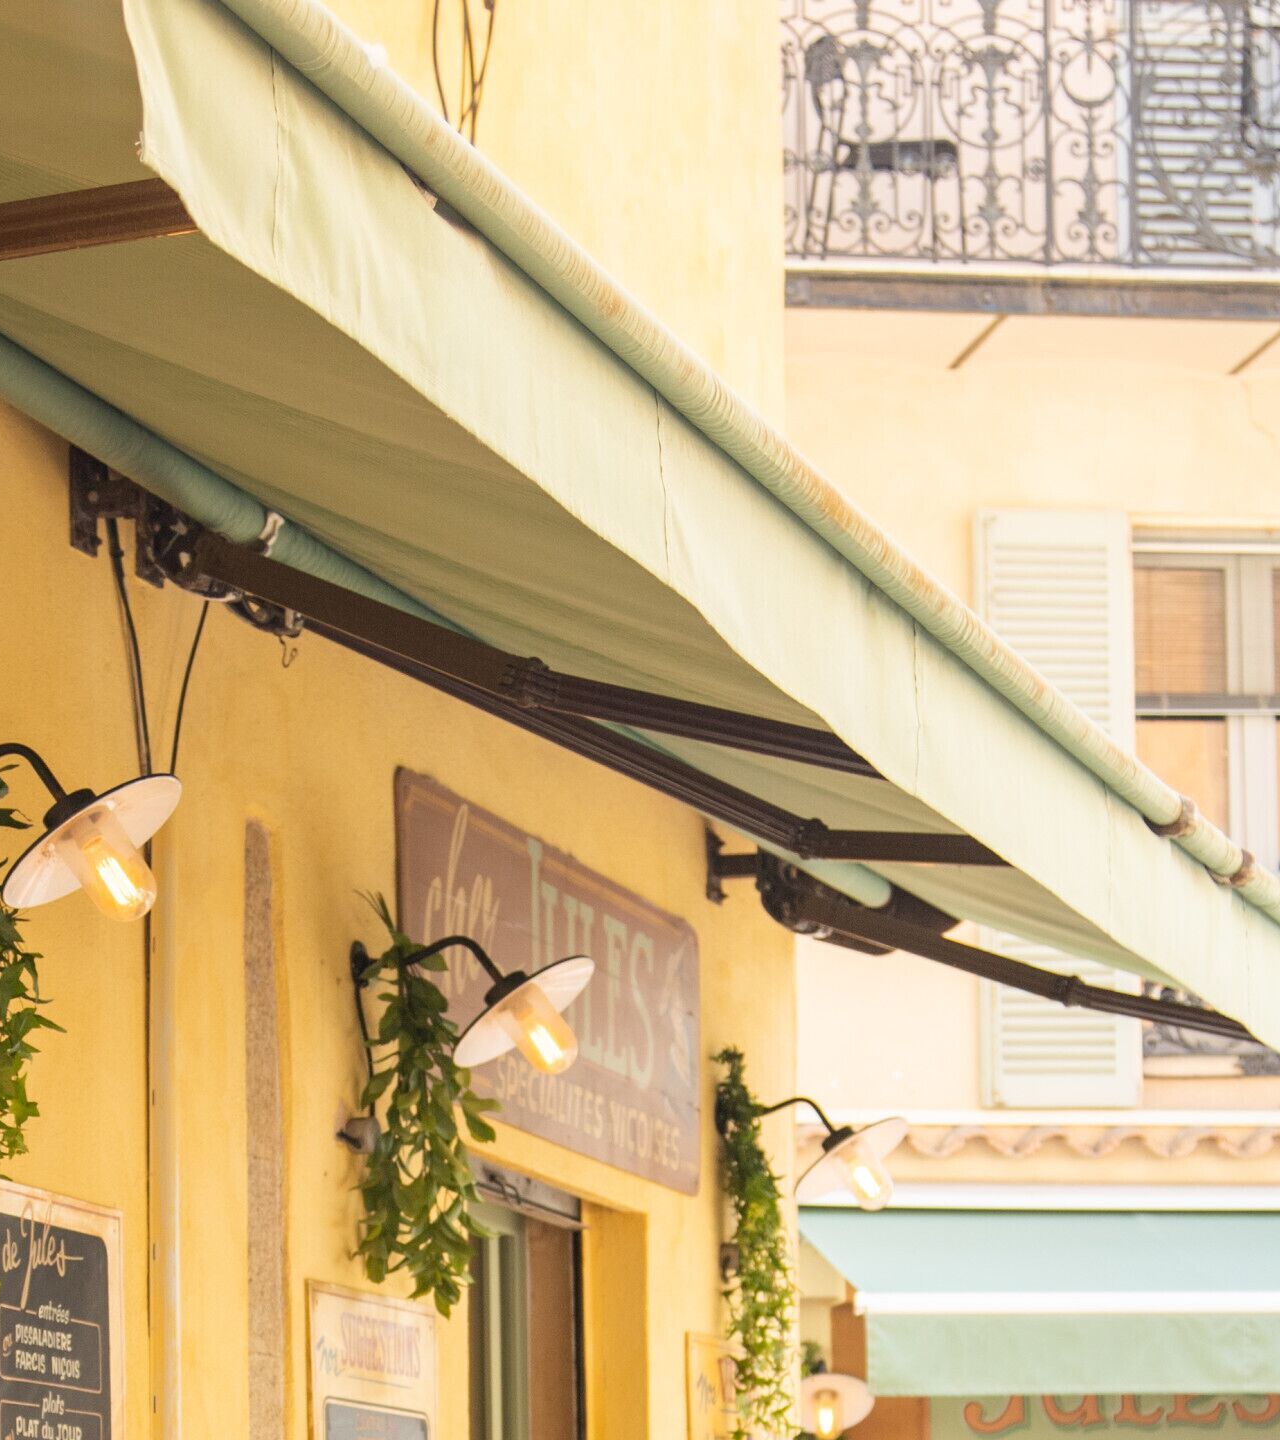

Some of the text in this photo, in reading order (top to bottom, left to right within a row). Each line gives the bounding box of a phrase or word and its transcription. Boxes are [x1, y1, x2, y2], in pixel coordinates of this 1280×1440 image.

[2, 1200, 84, 1309] de Jules
[38, 1300, 70, 1325] entrées
[15, 1350, 46, 1375] FARCIS
[41, 1391, 66, 1419] plats
[16, 1416, 40, 1438] PLAT
[41, 1421, 54, 1440] du
